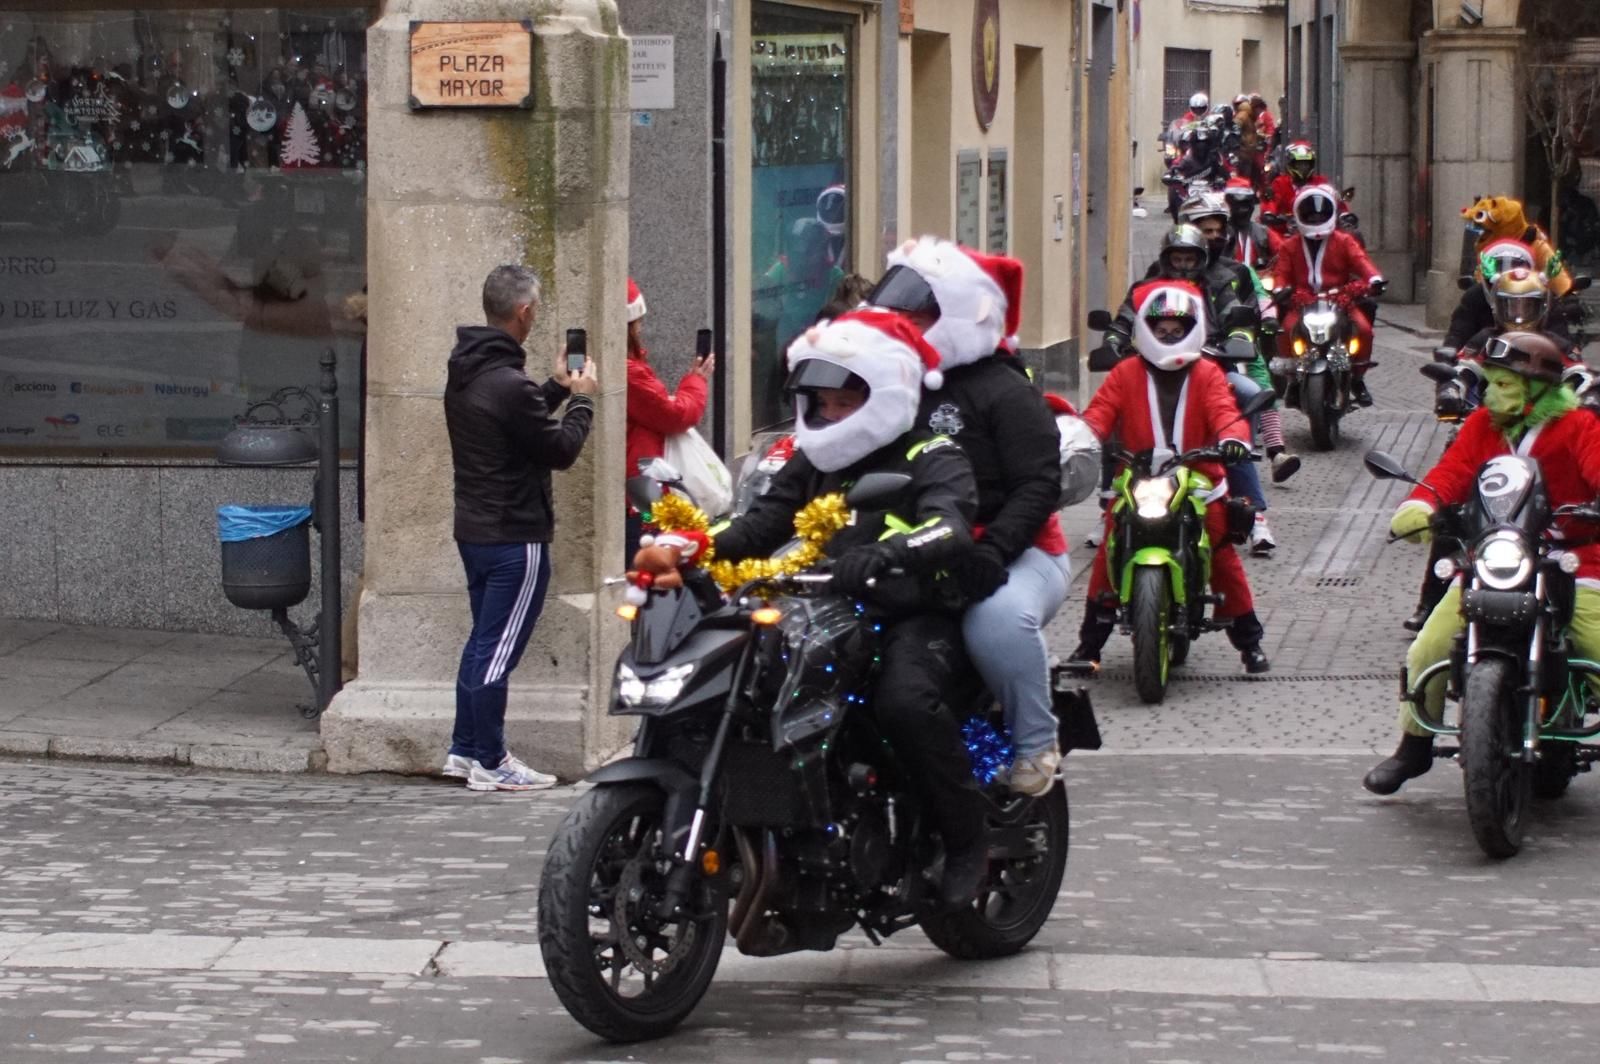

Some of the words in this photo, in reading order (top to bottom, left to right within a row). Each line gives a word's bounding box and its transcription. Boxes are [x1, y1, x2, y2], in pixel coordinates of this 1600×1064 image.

[440, 55, 505, 72] PLAZA
[440, 79, 505, 97] MAYOR
[14, 301, 47, 319] DE
[55, 301, 100, 319] LUZ
[106, 301, 120, 319] Y
[129, 301, 178, 319] GAS
[14, 380, 57, 393] acciona
[155, 383, 209, 397] Naturgy
